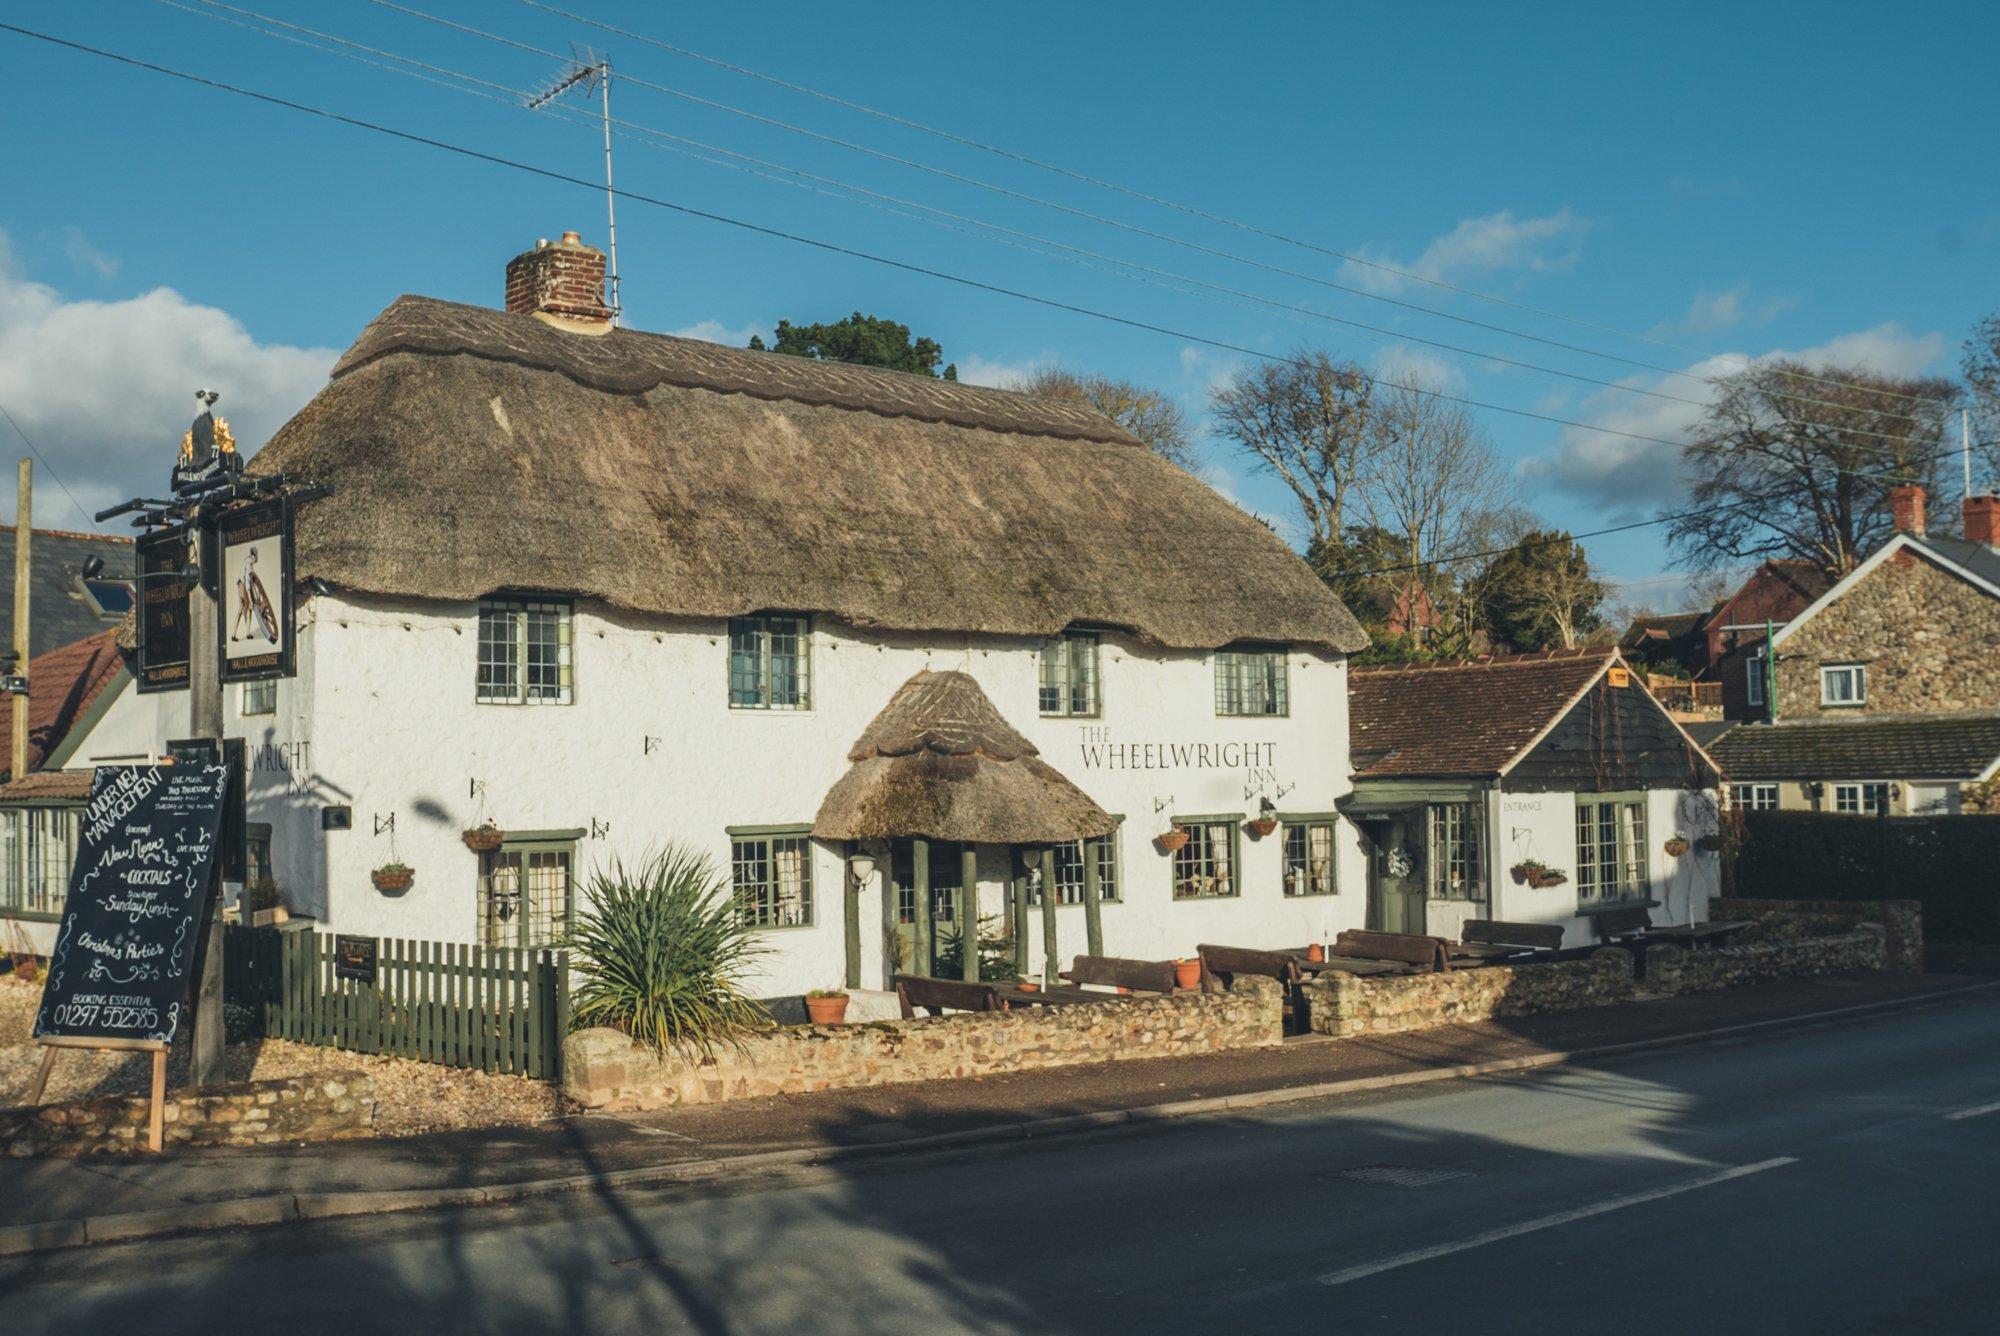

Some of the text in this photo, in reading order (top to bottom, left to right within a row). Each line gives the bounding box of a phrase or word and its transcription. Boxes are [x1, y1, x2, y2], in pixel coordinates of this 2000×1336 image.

[227, 519, 281, 544] WHEELWRIGHT
[145, 582, 187, 603] WHEELWRIGH
[161, 612, 174, 627] INN
[1079, 726, 1110, 743] THE
[1081, 743, 1277, 769] WHEELWRIGHT
[171, 776, 204, 784] LIVE MUSIC
[287, 775, 311, 797] INN
[1248, 768, 1276, 783] INN
[86, 765, 139, 821] UNDER NEW
[168, 785, 212, 796] THIS THURSDAY
[85, 765, 162, 847] MANAGEMENT
[1503, 802, 1542, 812] ENTRANCE
[128, 838, 164, 859] Menu
[177, 845, 188, 853] LIVE
[127, 869, 172, 885] COCKTAILS
[105, 894, 172, 923] Sunday Lunch
[77, 932, 164, 960] Christmas Parties
[72, 993, 152, 1007] BOOKING ESSENTIAL
[53, 1004, 158, 1029] 01297 552585
